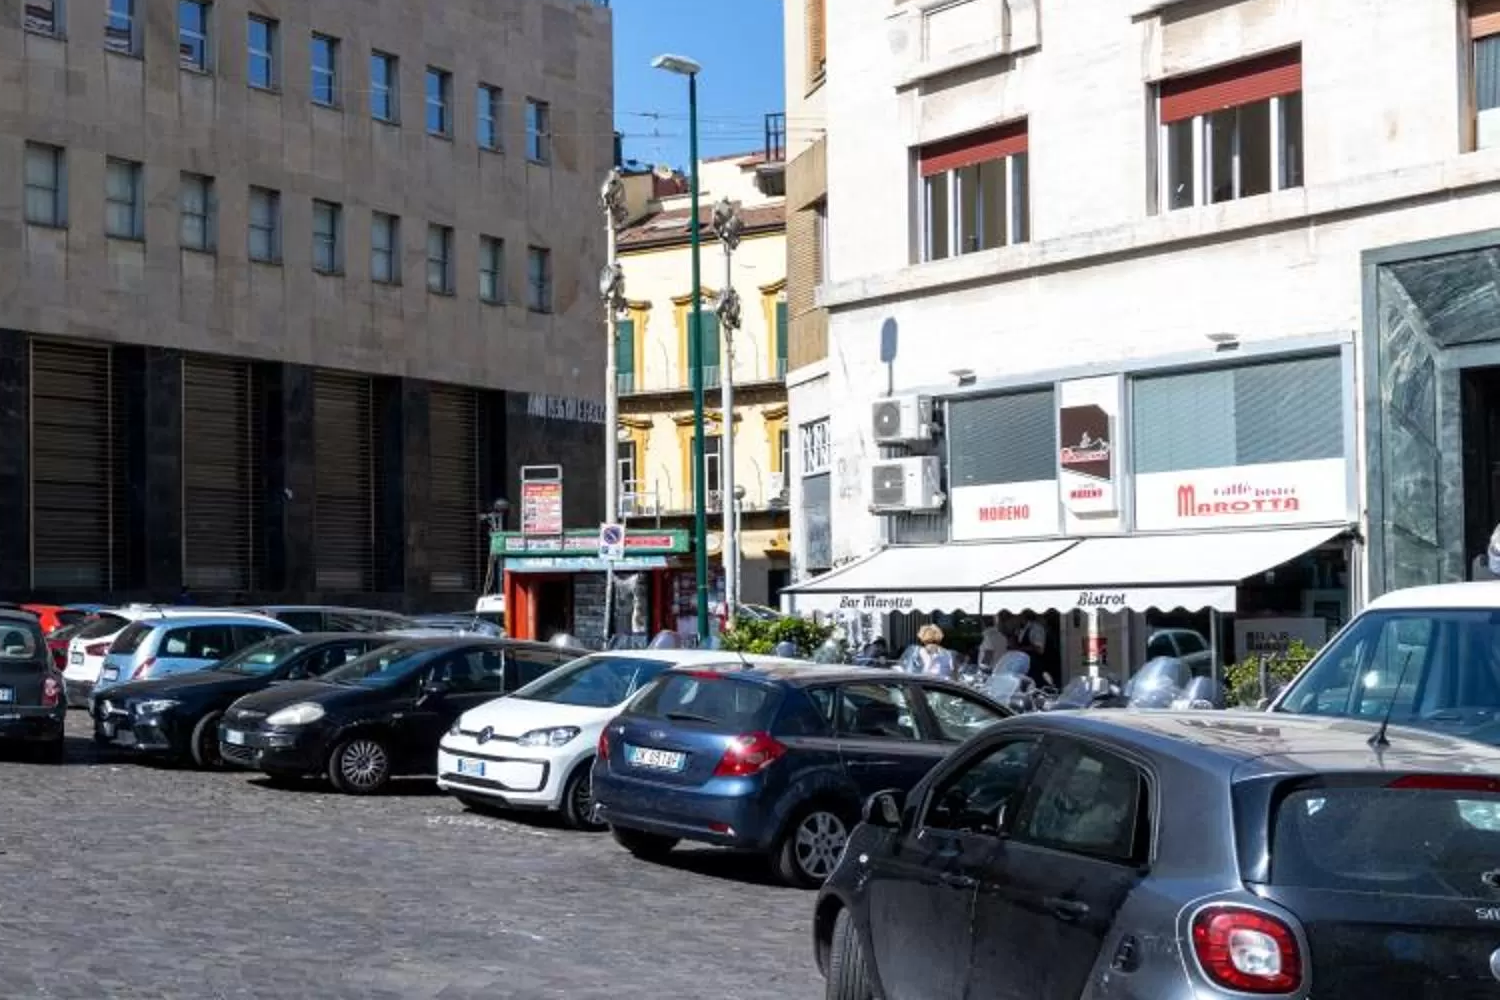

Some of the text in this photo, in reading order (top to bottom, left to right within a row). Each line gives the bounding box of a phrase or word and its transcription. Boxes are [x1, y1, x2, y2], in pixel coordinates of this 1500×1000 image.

[979, 504, 1030, 521] MORENO
[839, 595, 913, 608] Bar Marotta
[1077, 592, 1125, 606] Bistrot
